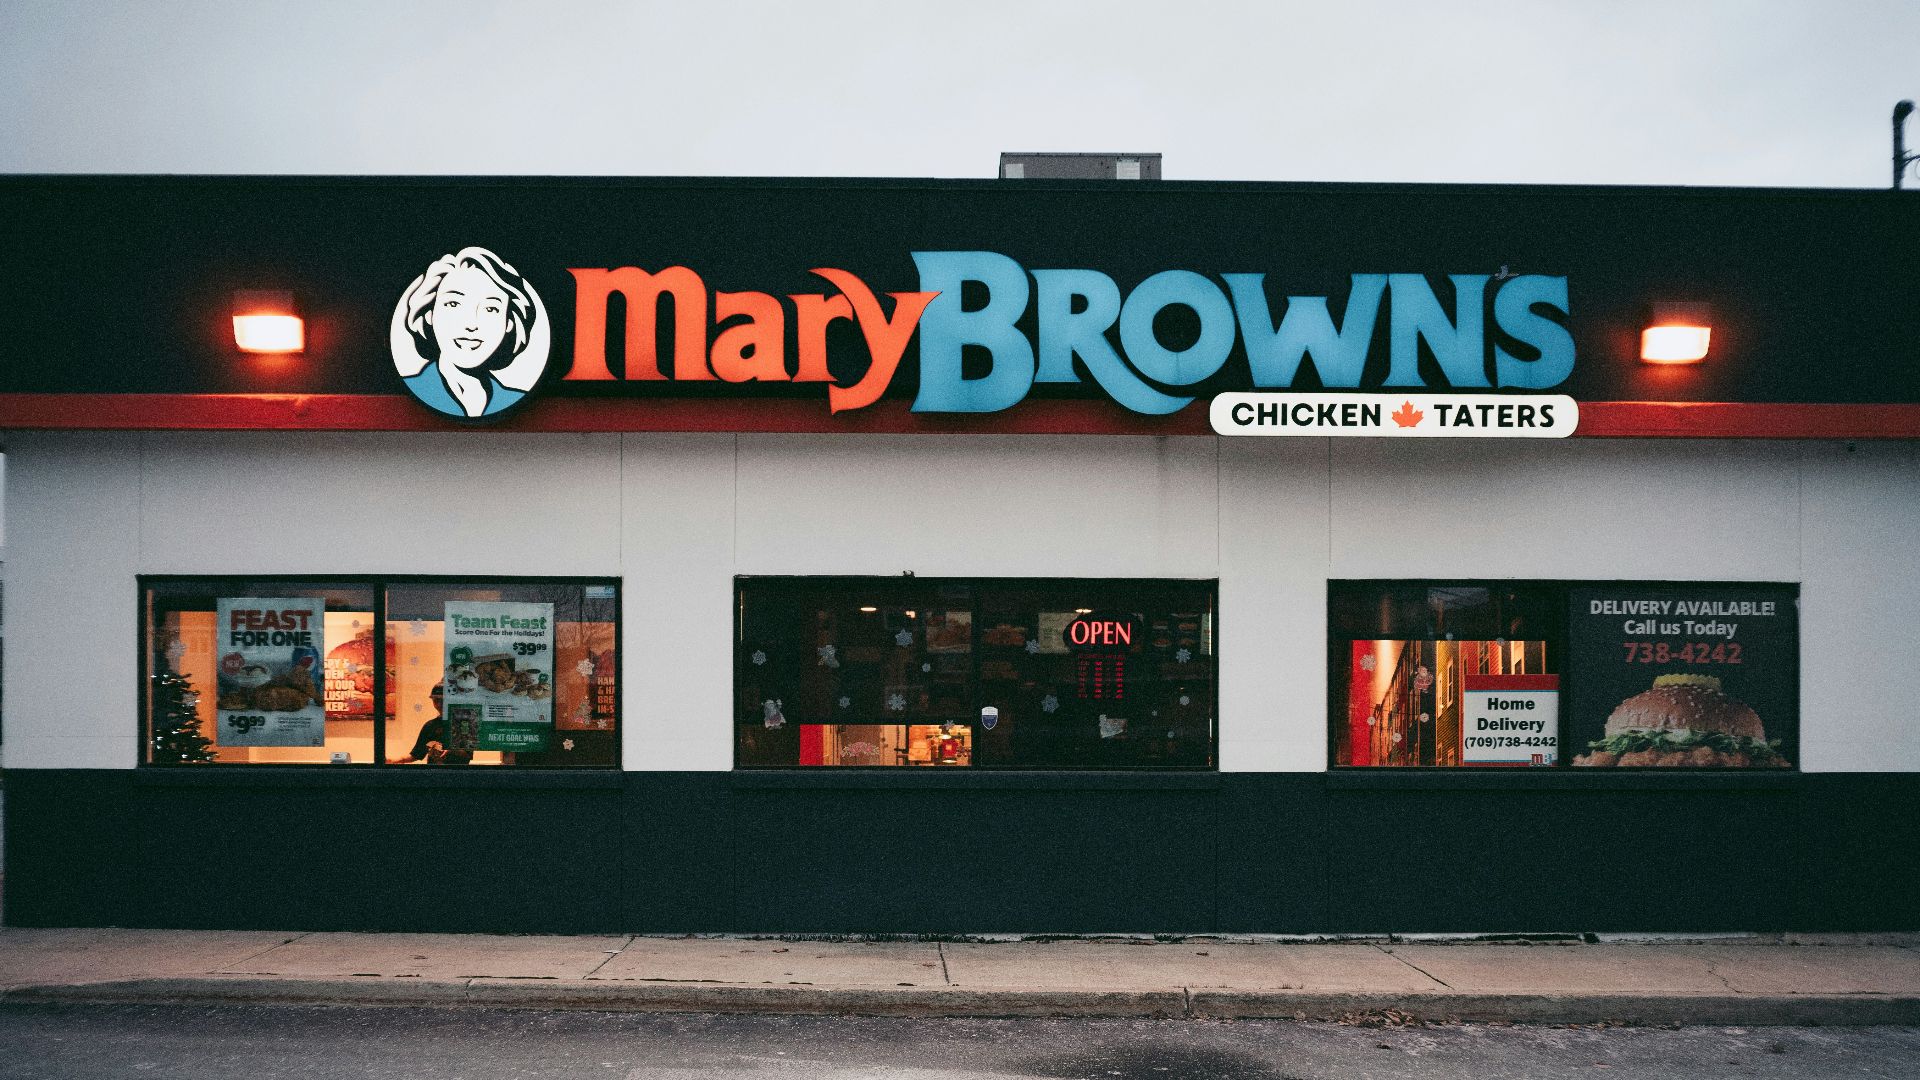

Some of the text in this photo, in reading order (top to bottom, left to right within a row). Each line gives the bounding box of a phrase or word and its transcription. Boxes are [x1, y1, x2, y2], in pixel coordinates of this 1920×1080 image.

[1231, 402, 1555, 428] CHICKEN TATERS
[1590, 600, 1776, 616] DELIVERY AVAILABLE!
[231, 610, 312, 630] FEAST
[451, 614, 547, 629] Team Feast
[1071, 620, 1131, 645] OPEN
[1624, 620, 1738, 639] Call us Today
[231, 631, 311, 646] FOR ONE
[1623, 642, 1743, 664] 738-4242
[226, 660, 240, 668] NEW
[1487, 697, 1535, 711] Home
[1477, 717, 1546, 733] Delivery
[488, 733, 505, 742] NEXT
[506, 734, 523, 742] GOAL
[1464, 736, 1557, 750] (709)738-4242
